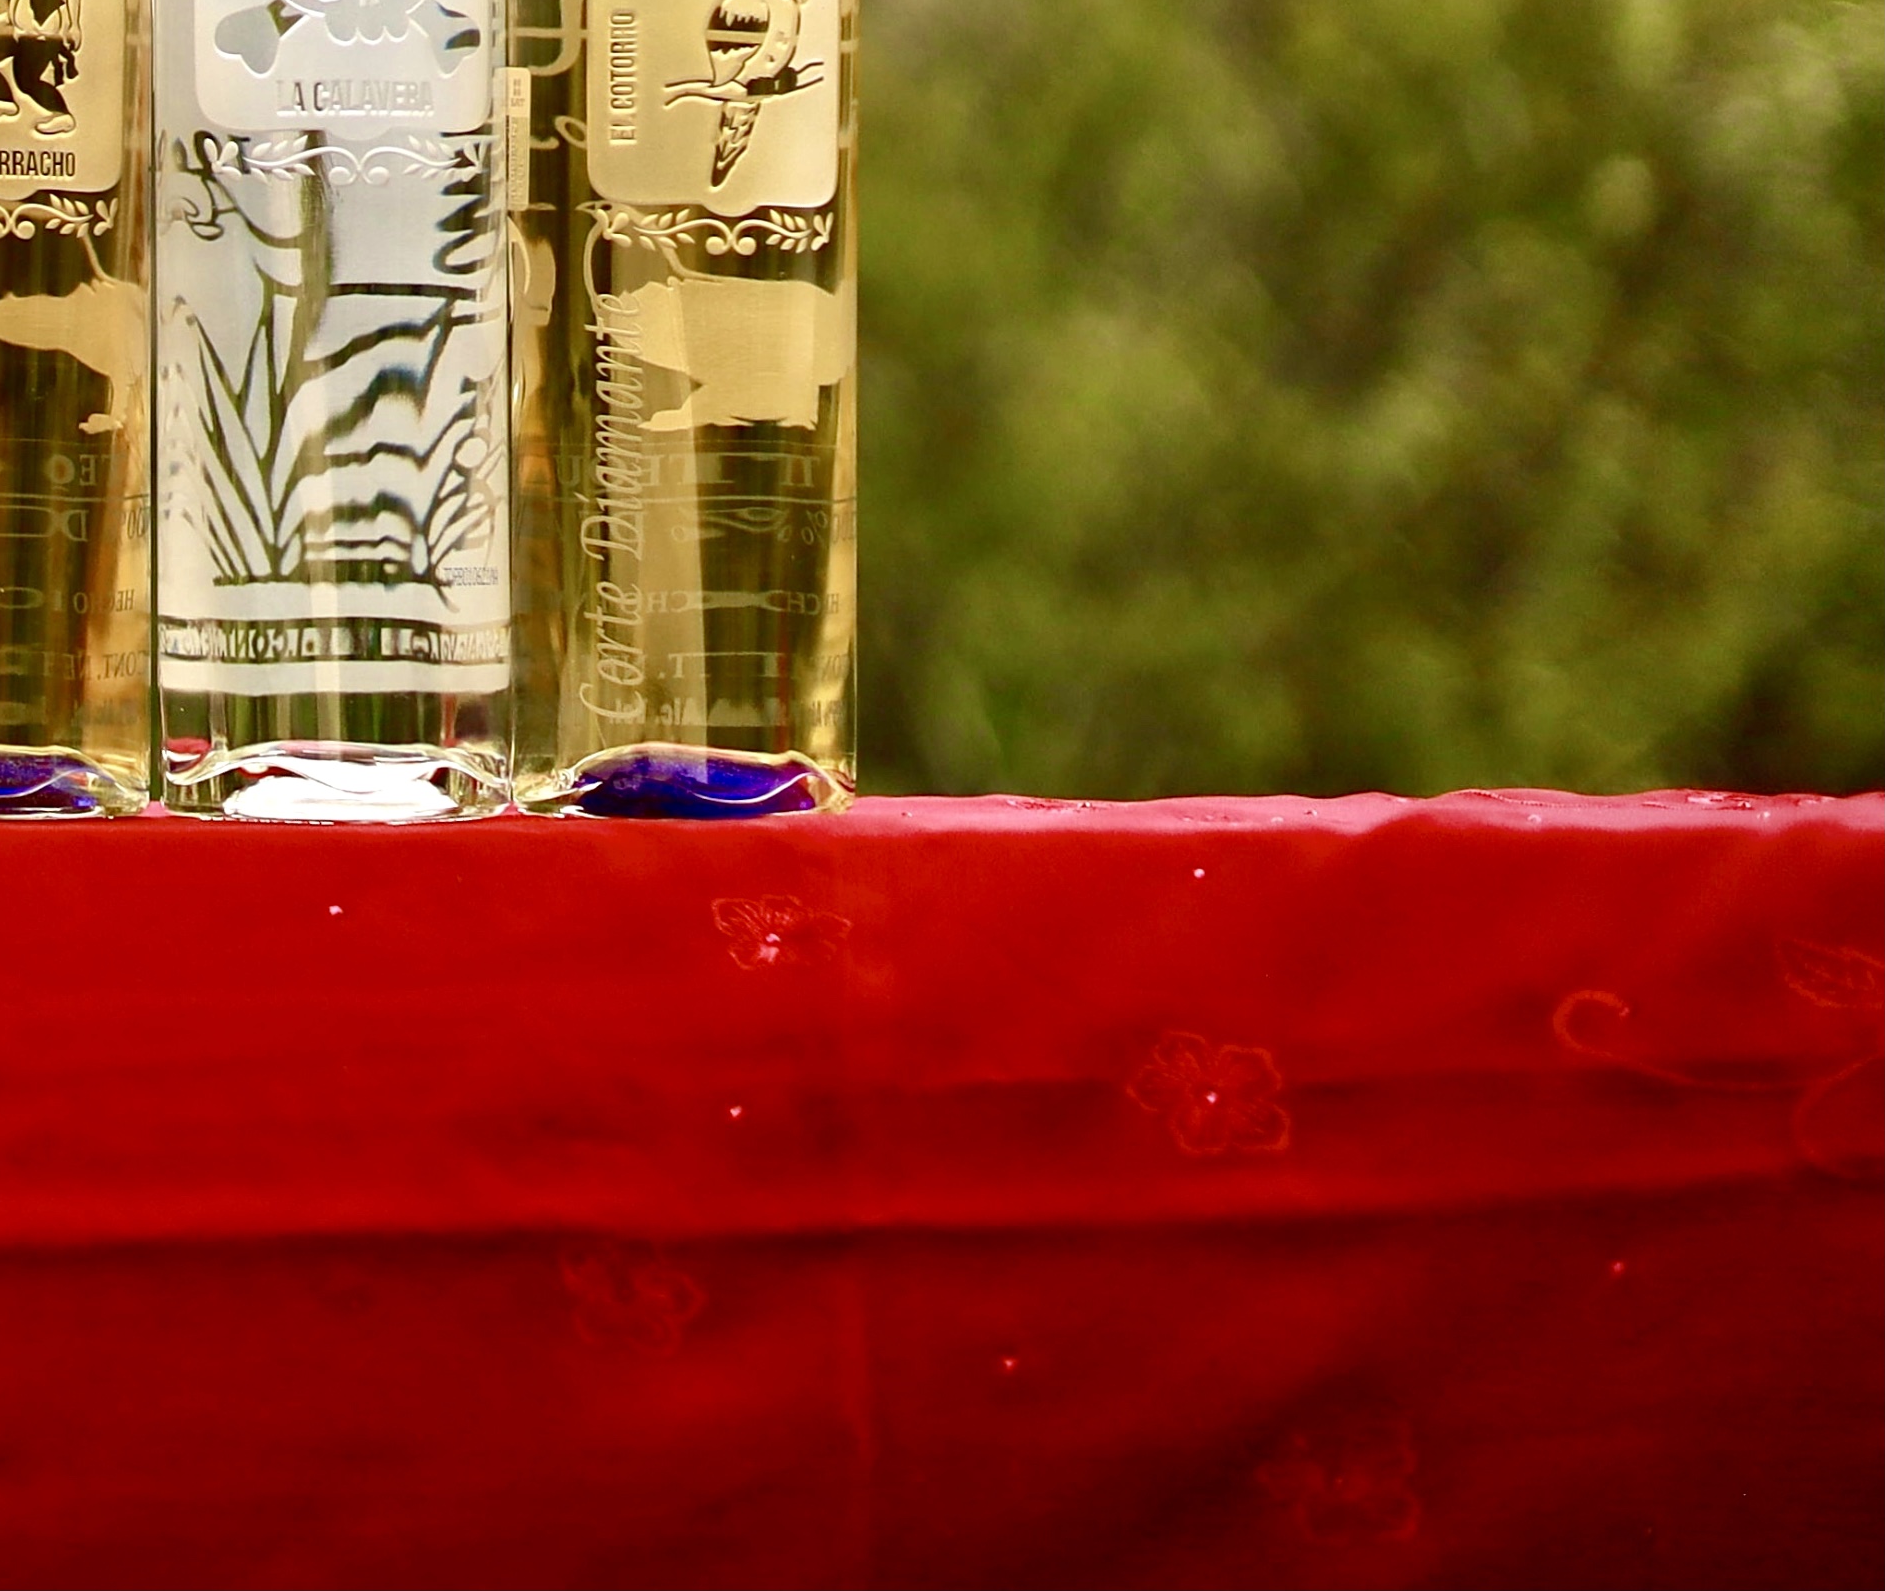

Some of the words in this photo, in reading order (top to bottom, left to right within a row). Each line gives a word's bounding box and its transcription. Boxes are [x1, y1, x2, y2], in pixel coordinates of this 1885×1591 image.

[276, 80, 308, 116] LA
[312, 80, 435, 116] CALAVERA
[609, 11, 639, 115] COTORRO
[609, 124, 638, 146] EL
[579, 578, 646, 722] Corte
